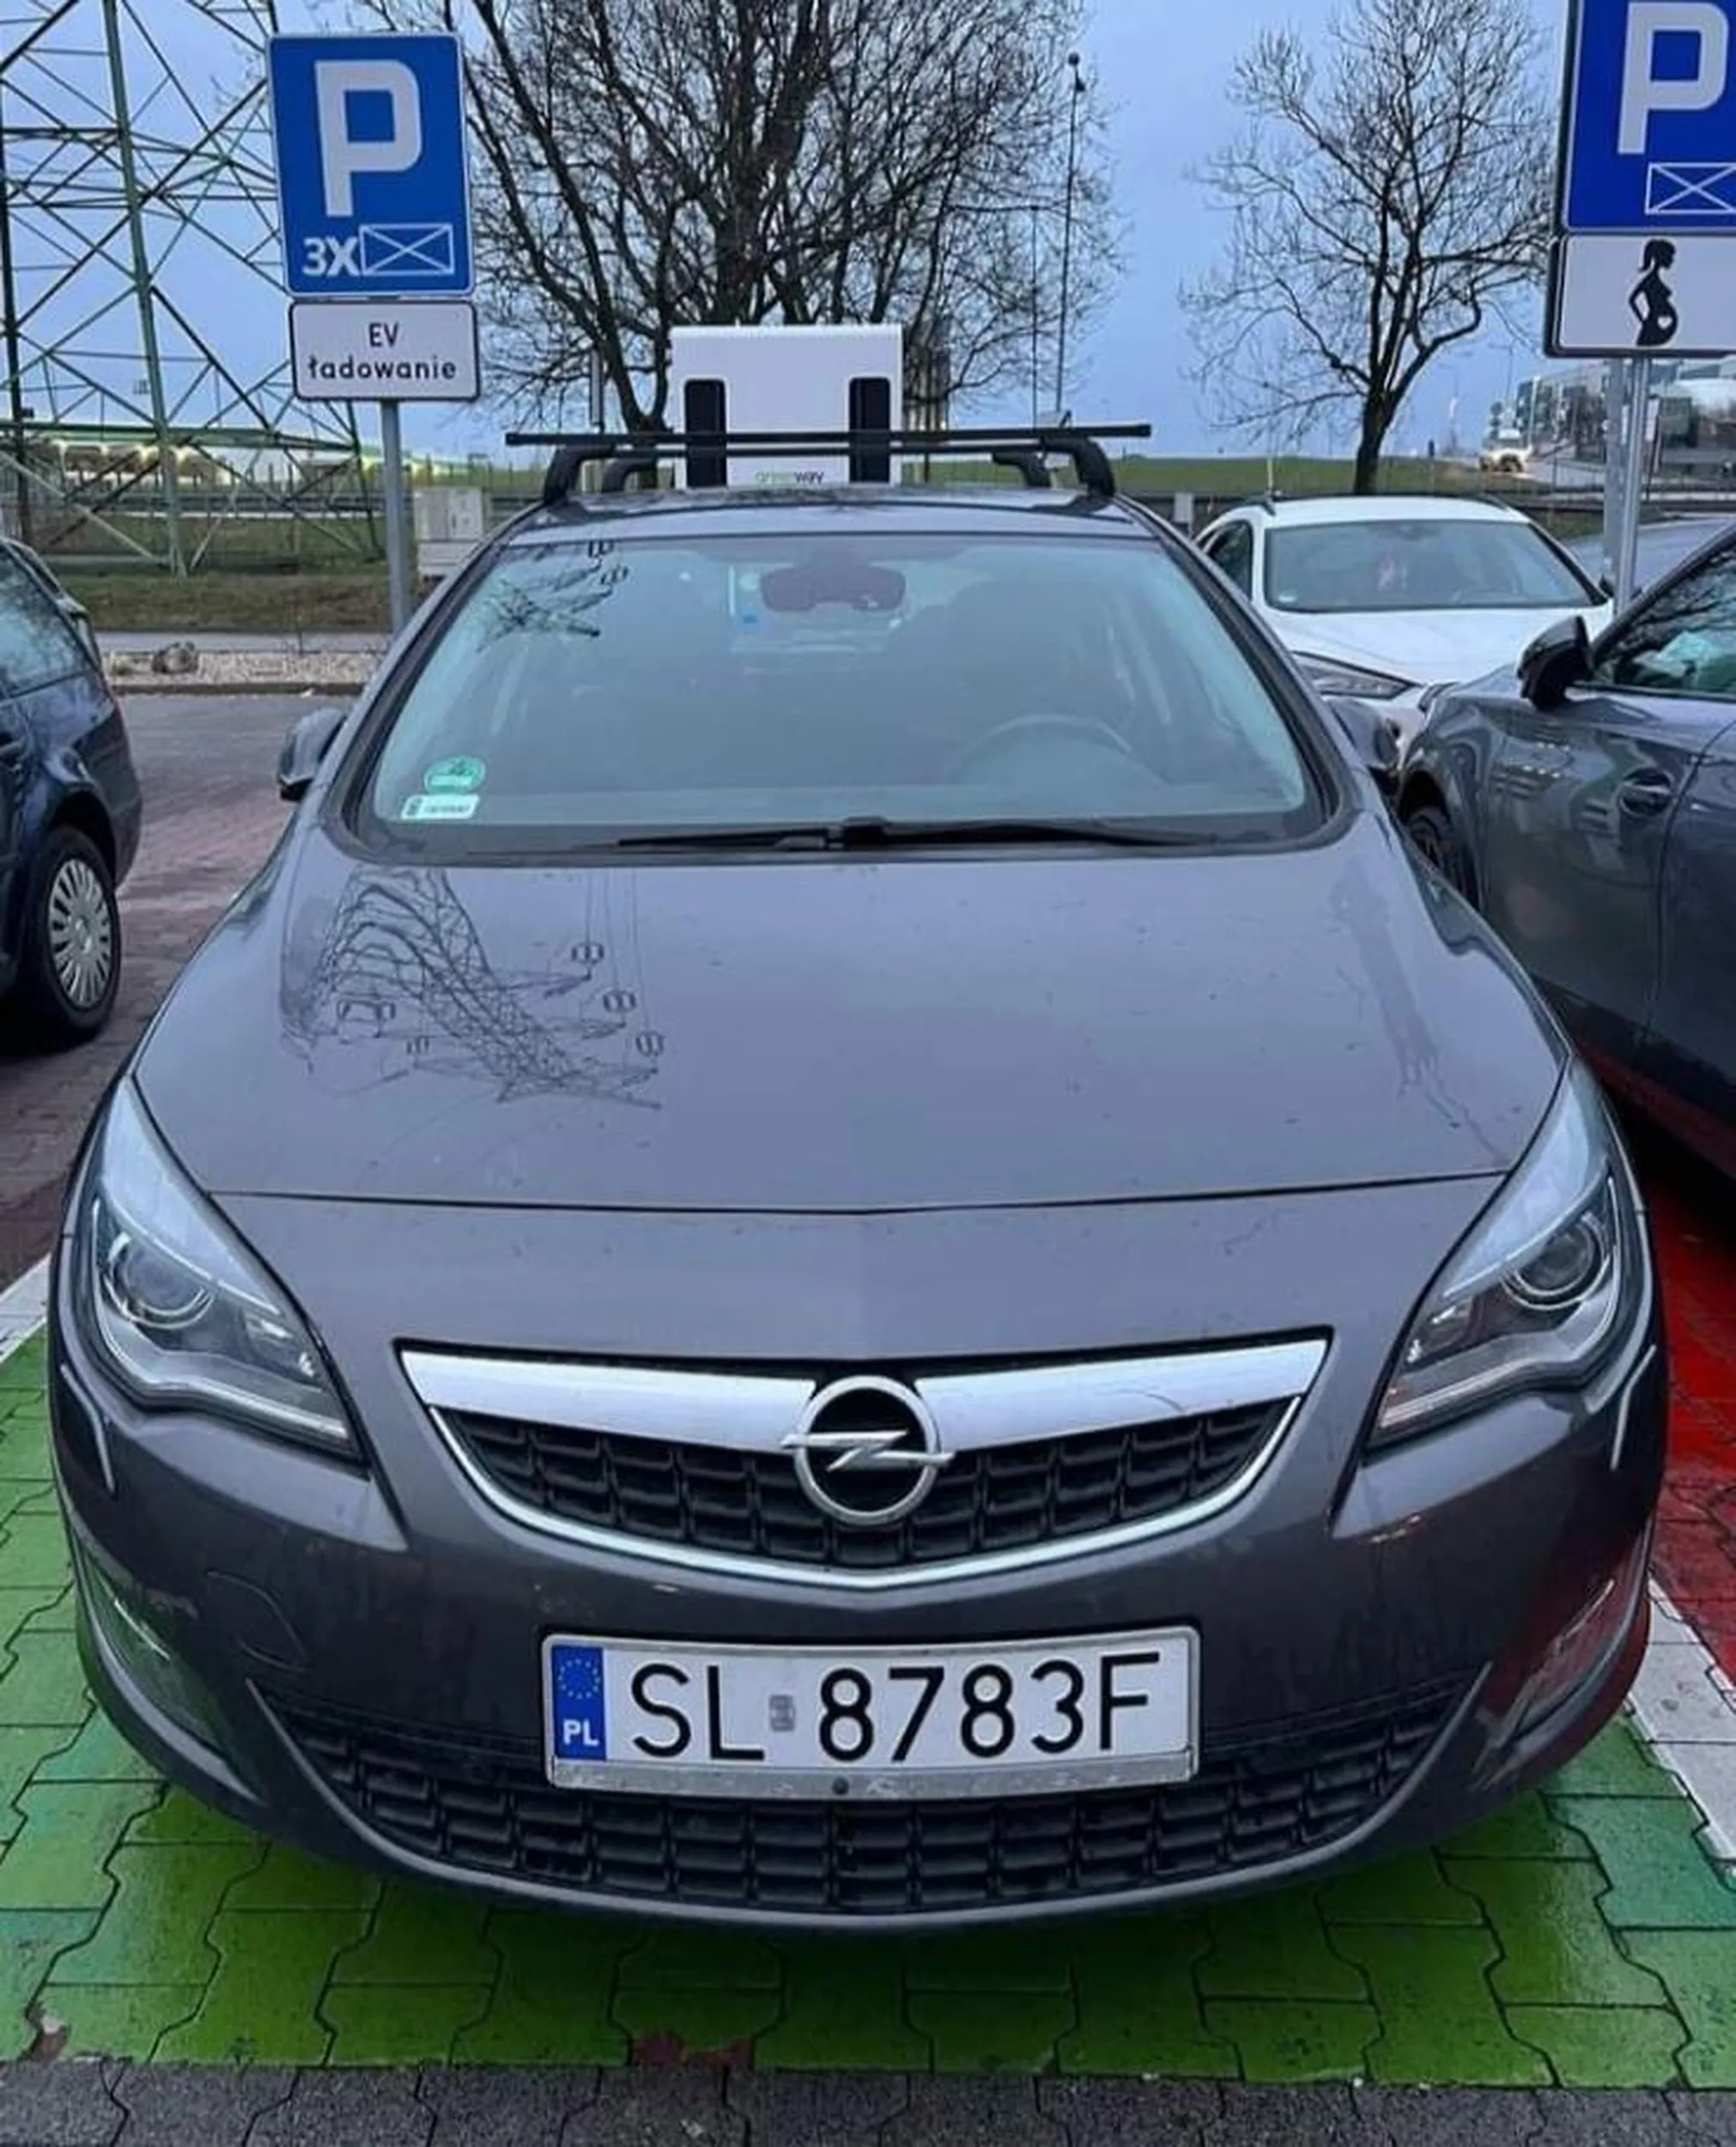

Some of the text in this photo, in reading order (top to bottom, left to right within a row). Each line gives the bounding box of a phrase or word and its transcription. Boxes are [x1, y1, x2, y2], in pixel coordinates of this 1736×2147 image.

[1617, 2, 1730, 155] P
[314, 59, 423, 217] P
[301, 235, 361, 278] 3X
[368, 321, 398, 348] EV
[307, 354, 457, 380] ładowanie
[631, 1651, 1161, 1762] SL 8783F
[561, 1718, 599, 1747] PL
